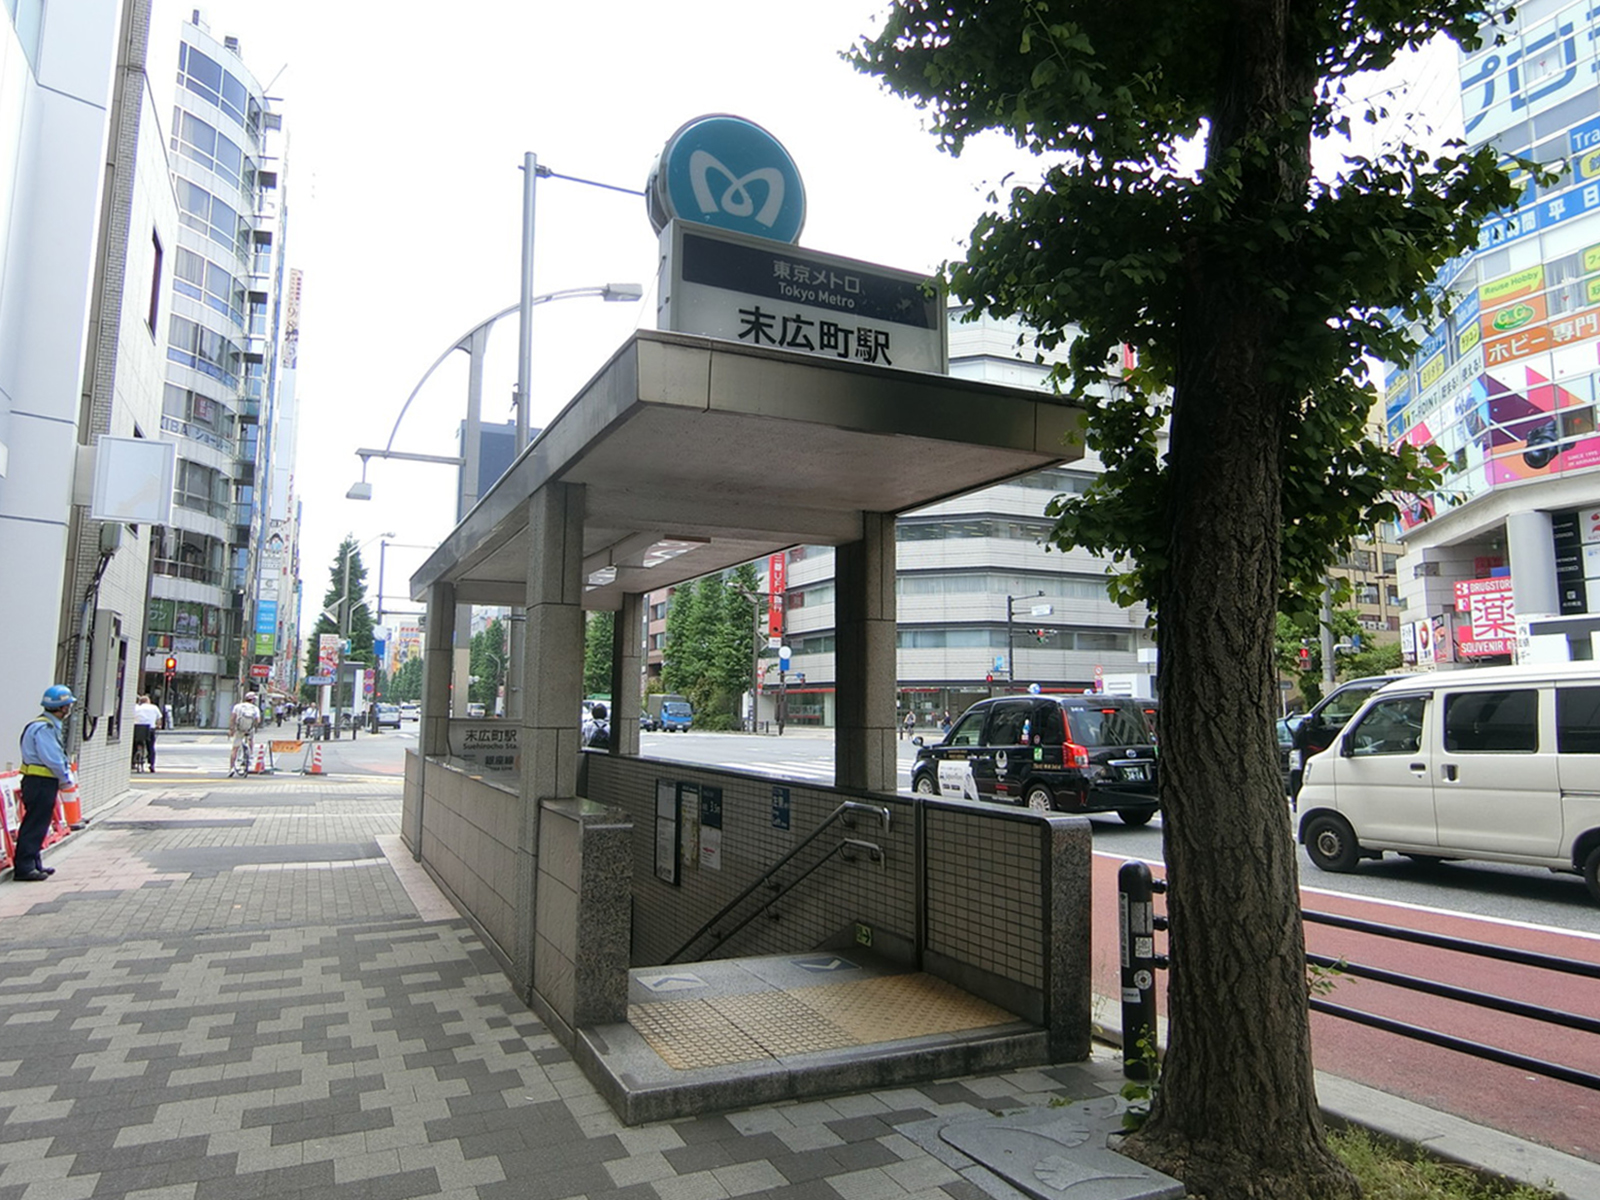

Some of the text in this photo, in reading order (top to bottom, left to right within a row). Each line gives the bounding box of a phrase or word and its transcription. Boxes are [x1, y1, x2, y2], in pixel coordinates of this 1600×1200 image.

[772, 259, 860, 293] 東京メトロ
[1511, 270, 1538, 288] Hobby
[778, 281, 855, 309] Tokyo Metro
[738, 306, 892, 366] 末広町駅
[1470, 579, 1511, 593] DRUGSTOR
[1473, 594, 1516, 637] 薬
[1461, 641, 1504, 653] SOUVENIR
[465, 729, 517, 742] 末広町駅
